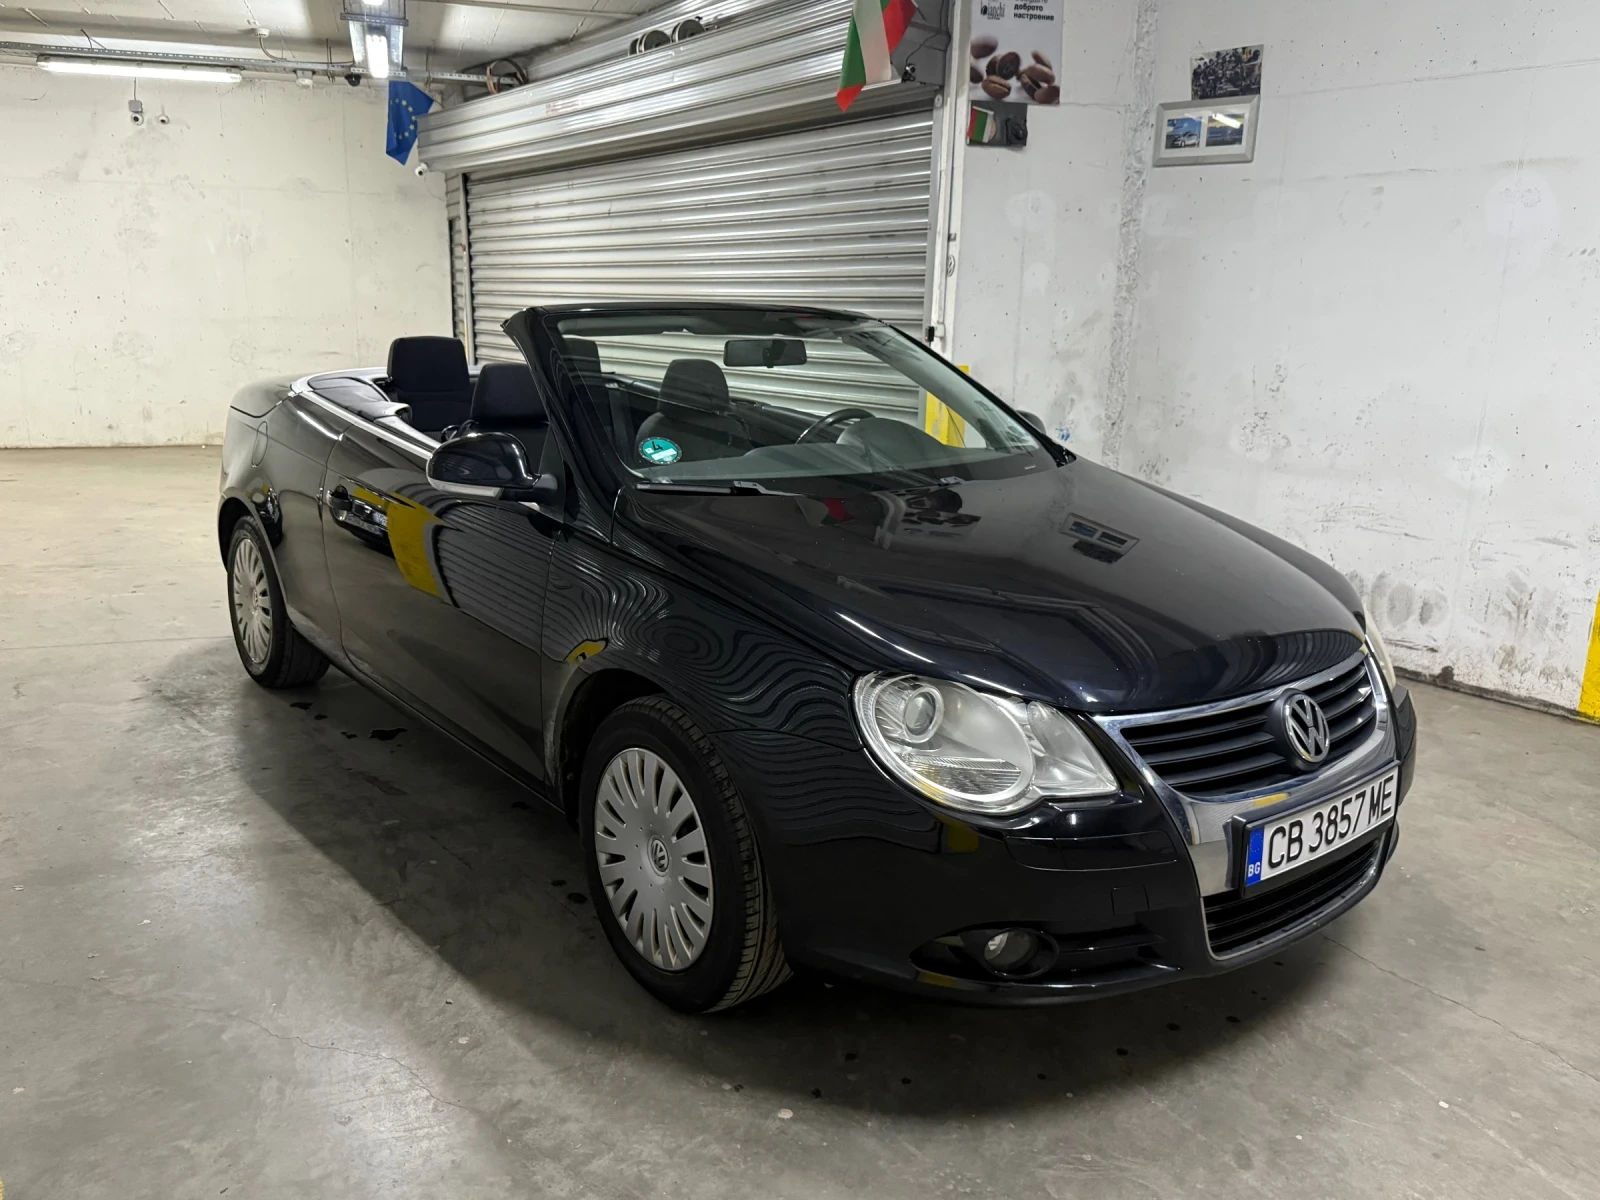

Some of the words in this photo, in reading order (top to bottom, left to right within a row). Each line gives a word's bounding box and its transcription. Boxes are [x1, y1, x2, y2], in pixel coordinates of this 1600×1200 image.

[1014, 3, 1043, 12] доброто
[1014, 12, 1054, 21] настроение
[651, 441, 663, 451] 4
[1268, 819, 1303, 869] CB
[1308, 789, 1367, 853] 3857
[1367, 774, 1394, 826] ME
[1248, 862, 1261, 877] BG
